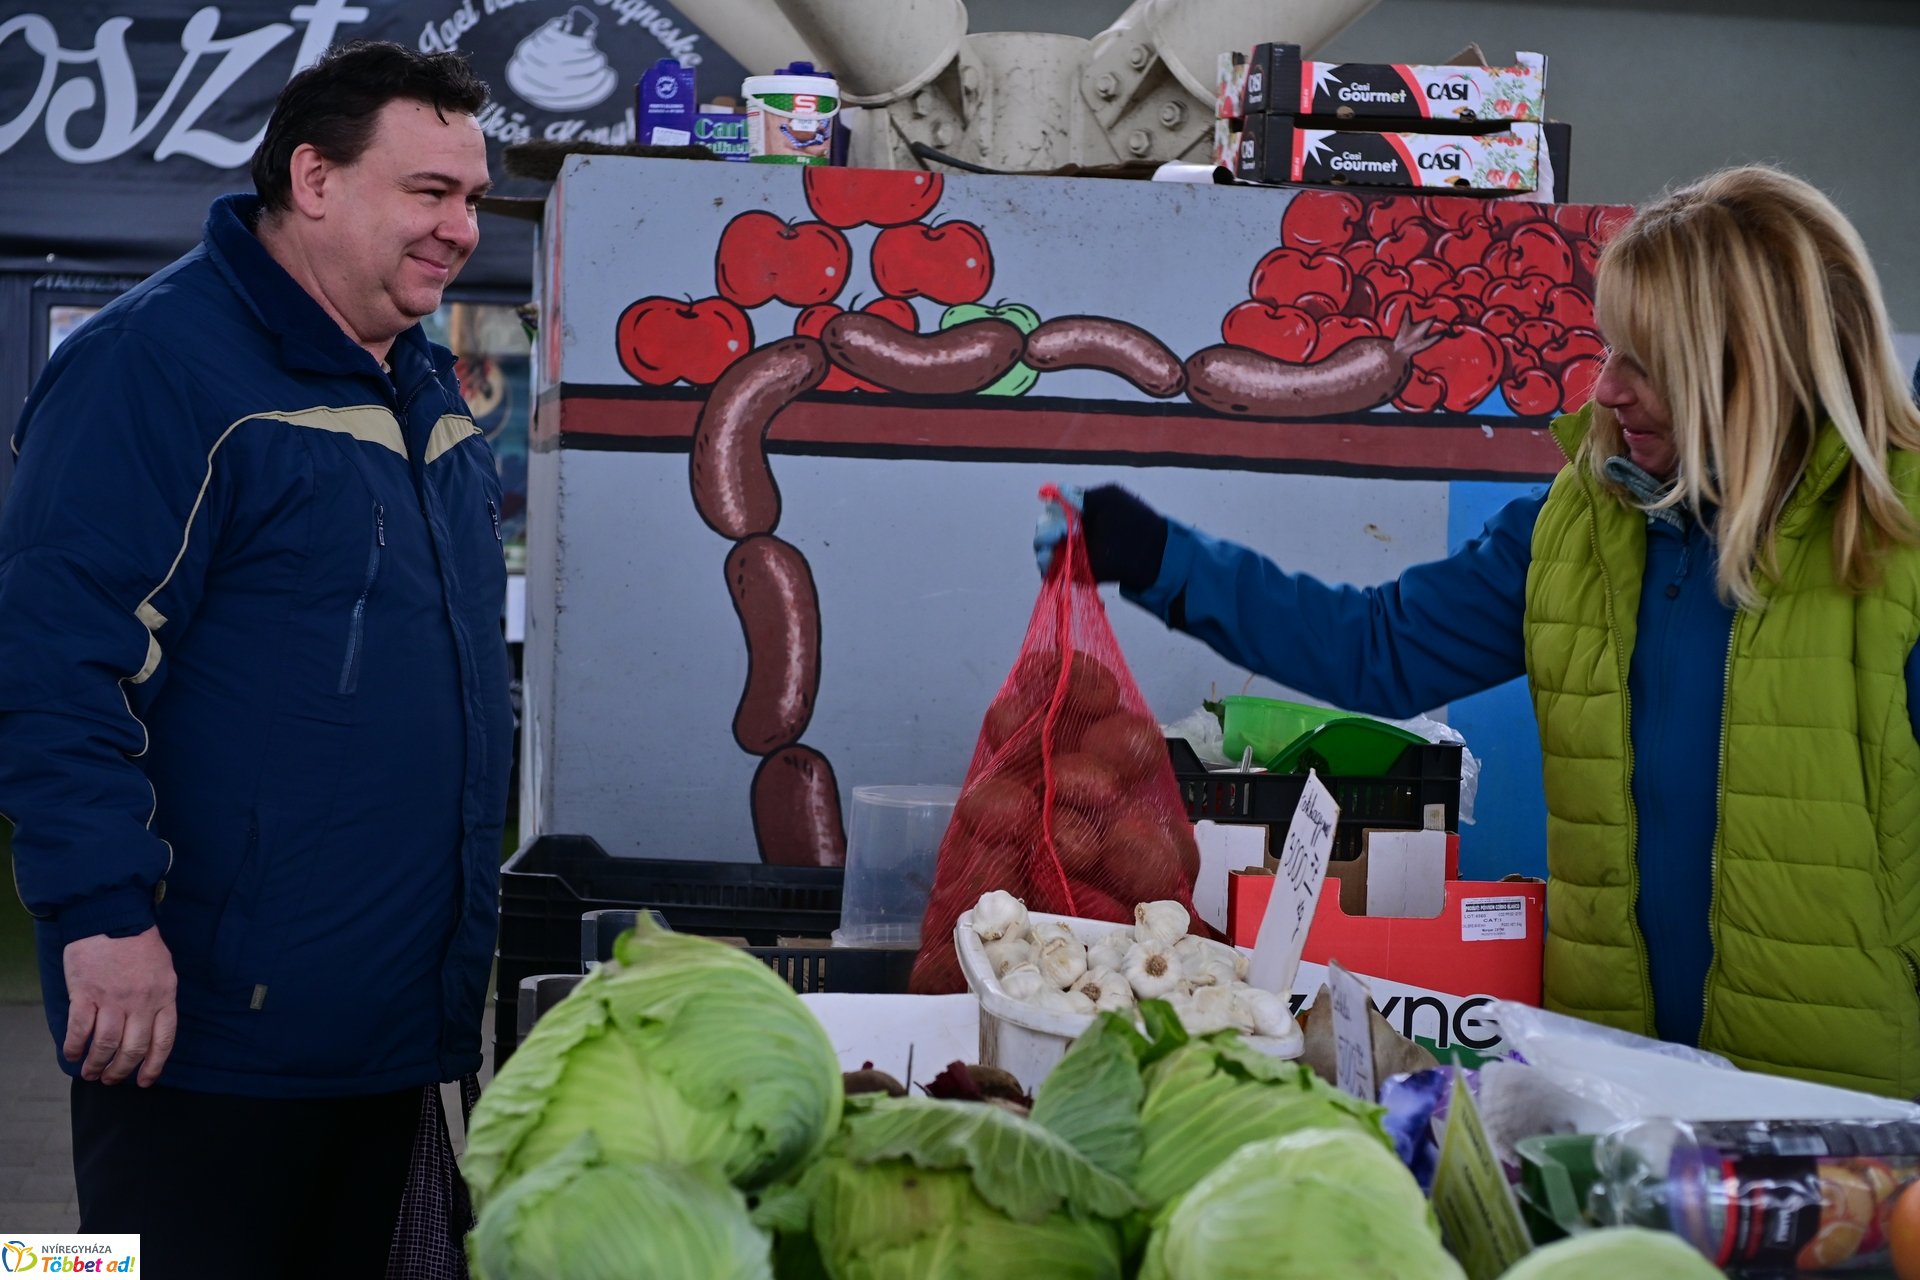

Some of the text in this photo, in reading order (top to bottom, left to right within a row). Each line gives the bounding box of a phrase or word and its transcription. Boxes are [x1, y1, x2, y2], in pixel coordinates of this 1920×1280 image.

[1351, 82, 1370, 91] Casi
[1426, 83, 1469, 101] CASI
[1338, 88, 1407, 103] Gourmet
[1342, 151, 1362, 161] Casi
[1418, 152, 1461, 170] CASI
[1330, 157, 1398, 172] Gourmet
